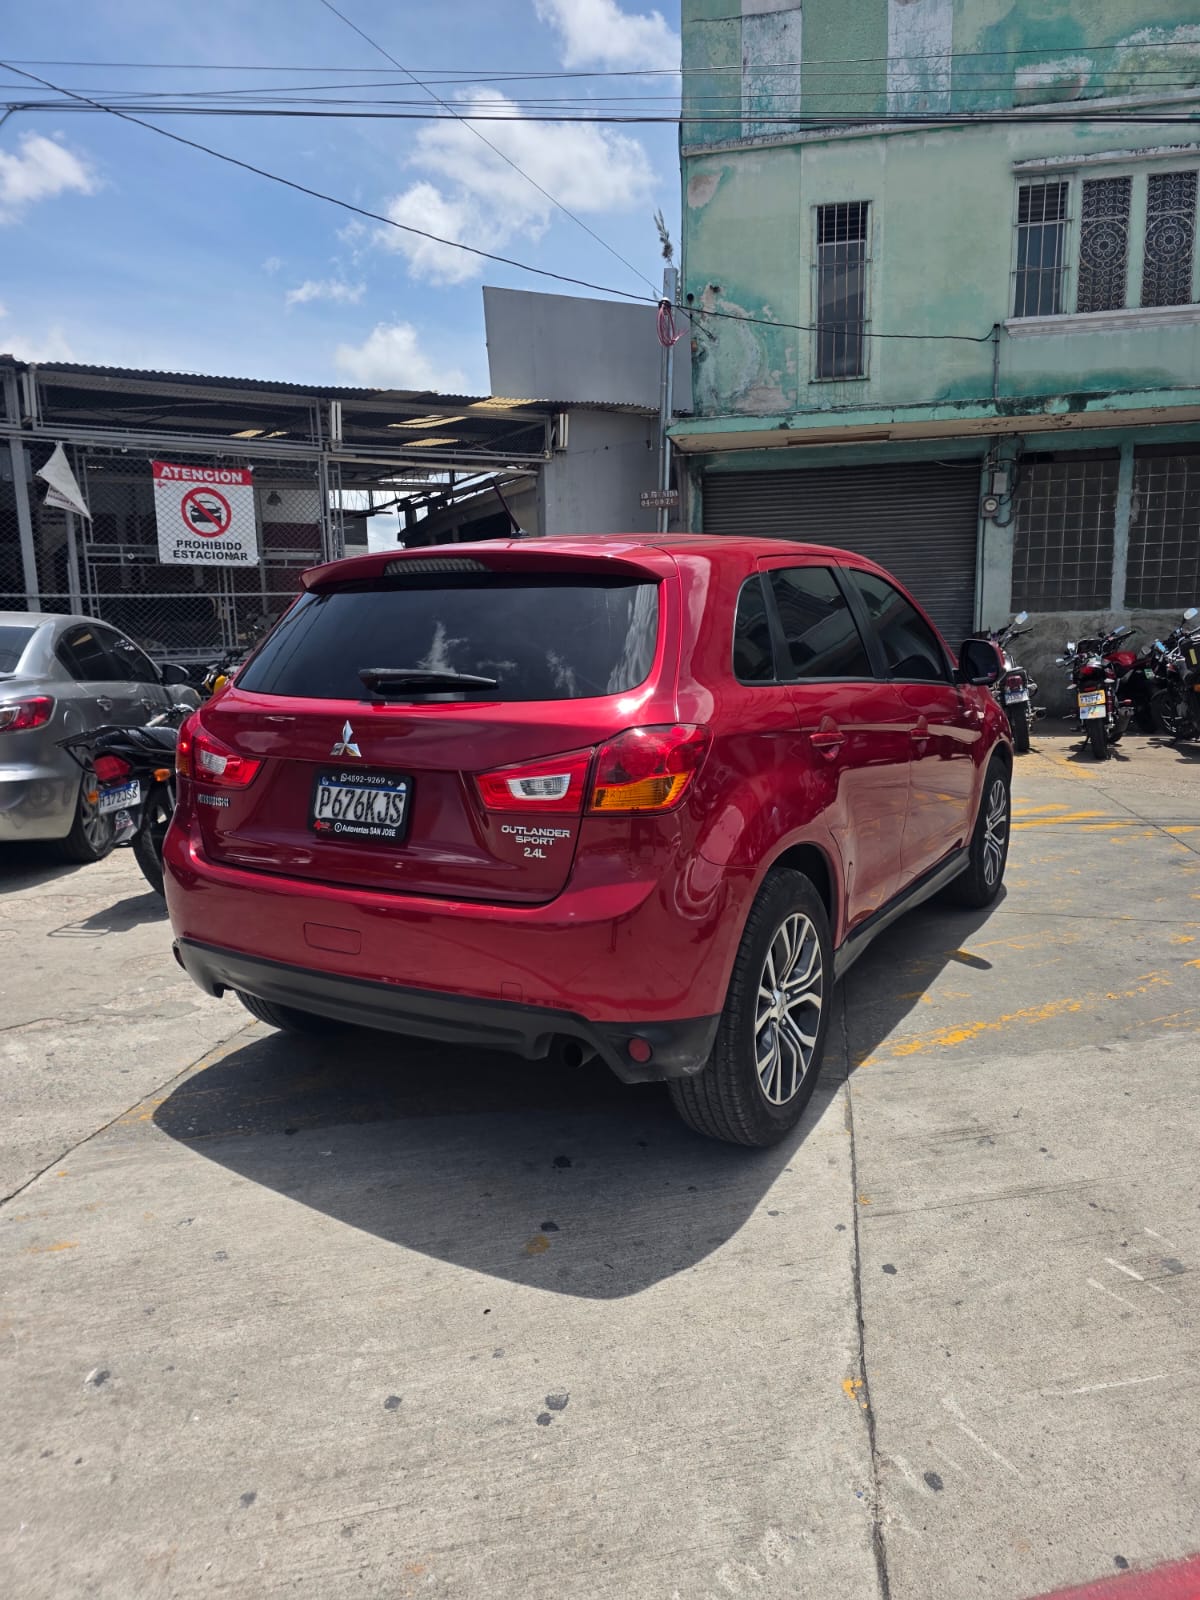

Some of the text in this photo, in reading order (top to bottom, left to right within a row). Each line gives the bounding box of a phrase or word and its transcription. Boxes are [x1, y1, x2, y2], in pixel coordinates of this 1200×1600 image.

[176, 540, 242, 551] PROHIBIDO
[173, 549, 248, 561] ESTACIONAR
[318, 786, 404, 824] P676KJS
[369, 826, 381, 836] SAN
[501, 825, 571, 838] OUTLANDER
[515, 835, 555, 846] SPORT
[523, 847, 547, 859] 2.4L
